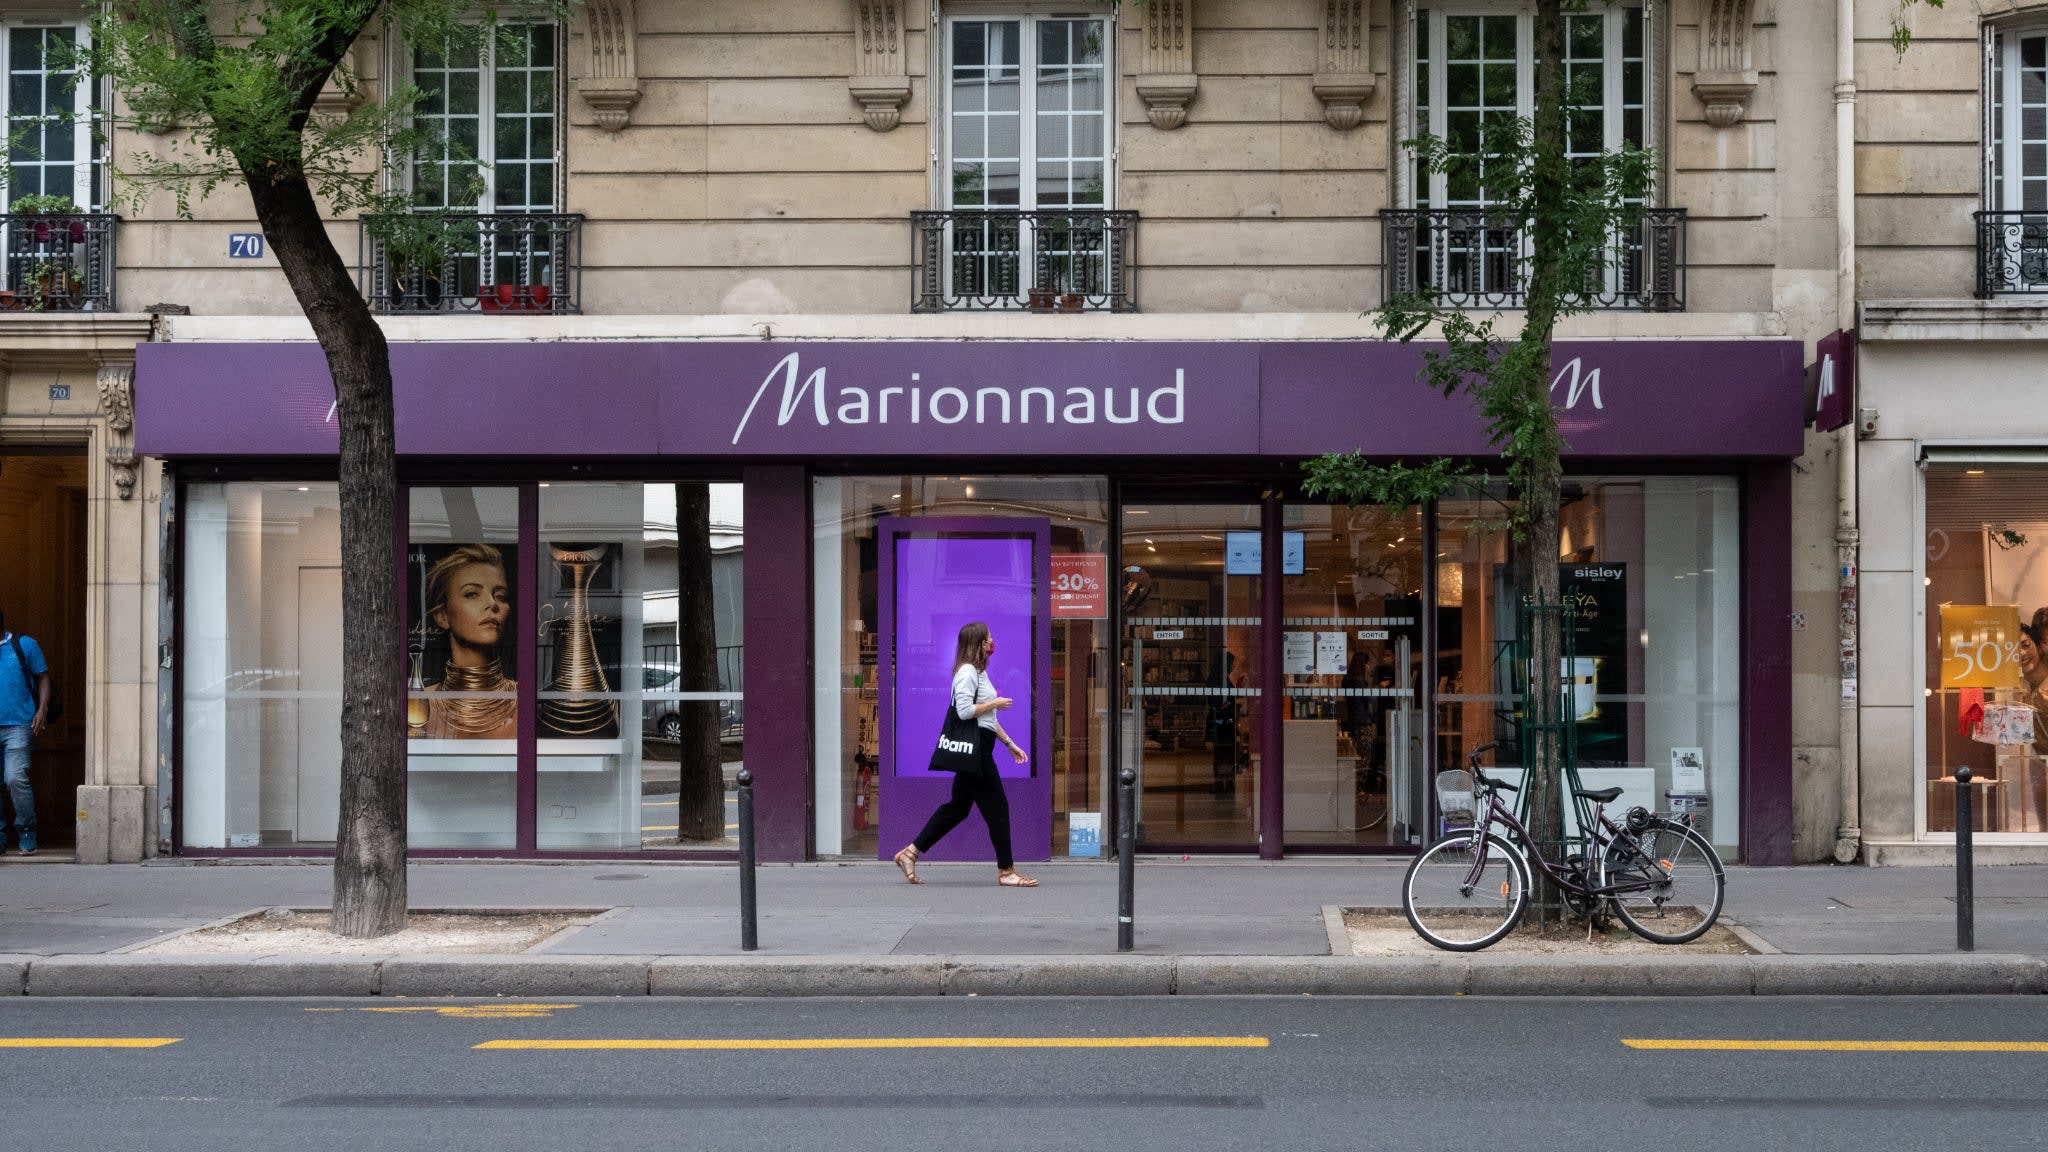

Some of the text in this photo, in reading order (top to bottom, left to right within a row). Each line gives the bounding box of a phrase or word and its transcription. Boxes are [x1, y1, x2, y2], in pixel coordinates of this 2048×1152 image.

[233, 235, 260, 256] 70
[52, 387, 66, 398] 70
[731, 351, 1185, 445] Marionnaud
[408, 553, 427, 563] IOR
[563, 551, 593, 562] DIOR
[1050, 573, 1099, 591] -30%
[1574, 567, 1623, 580] sisley
[1943, 641, 2020, 681] -50%
[938, 734, 974, 754] foam
